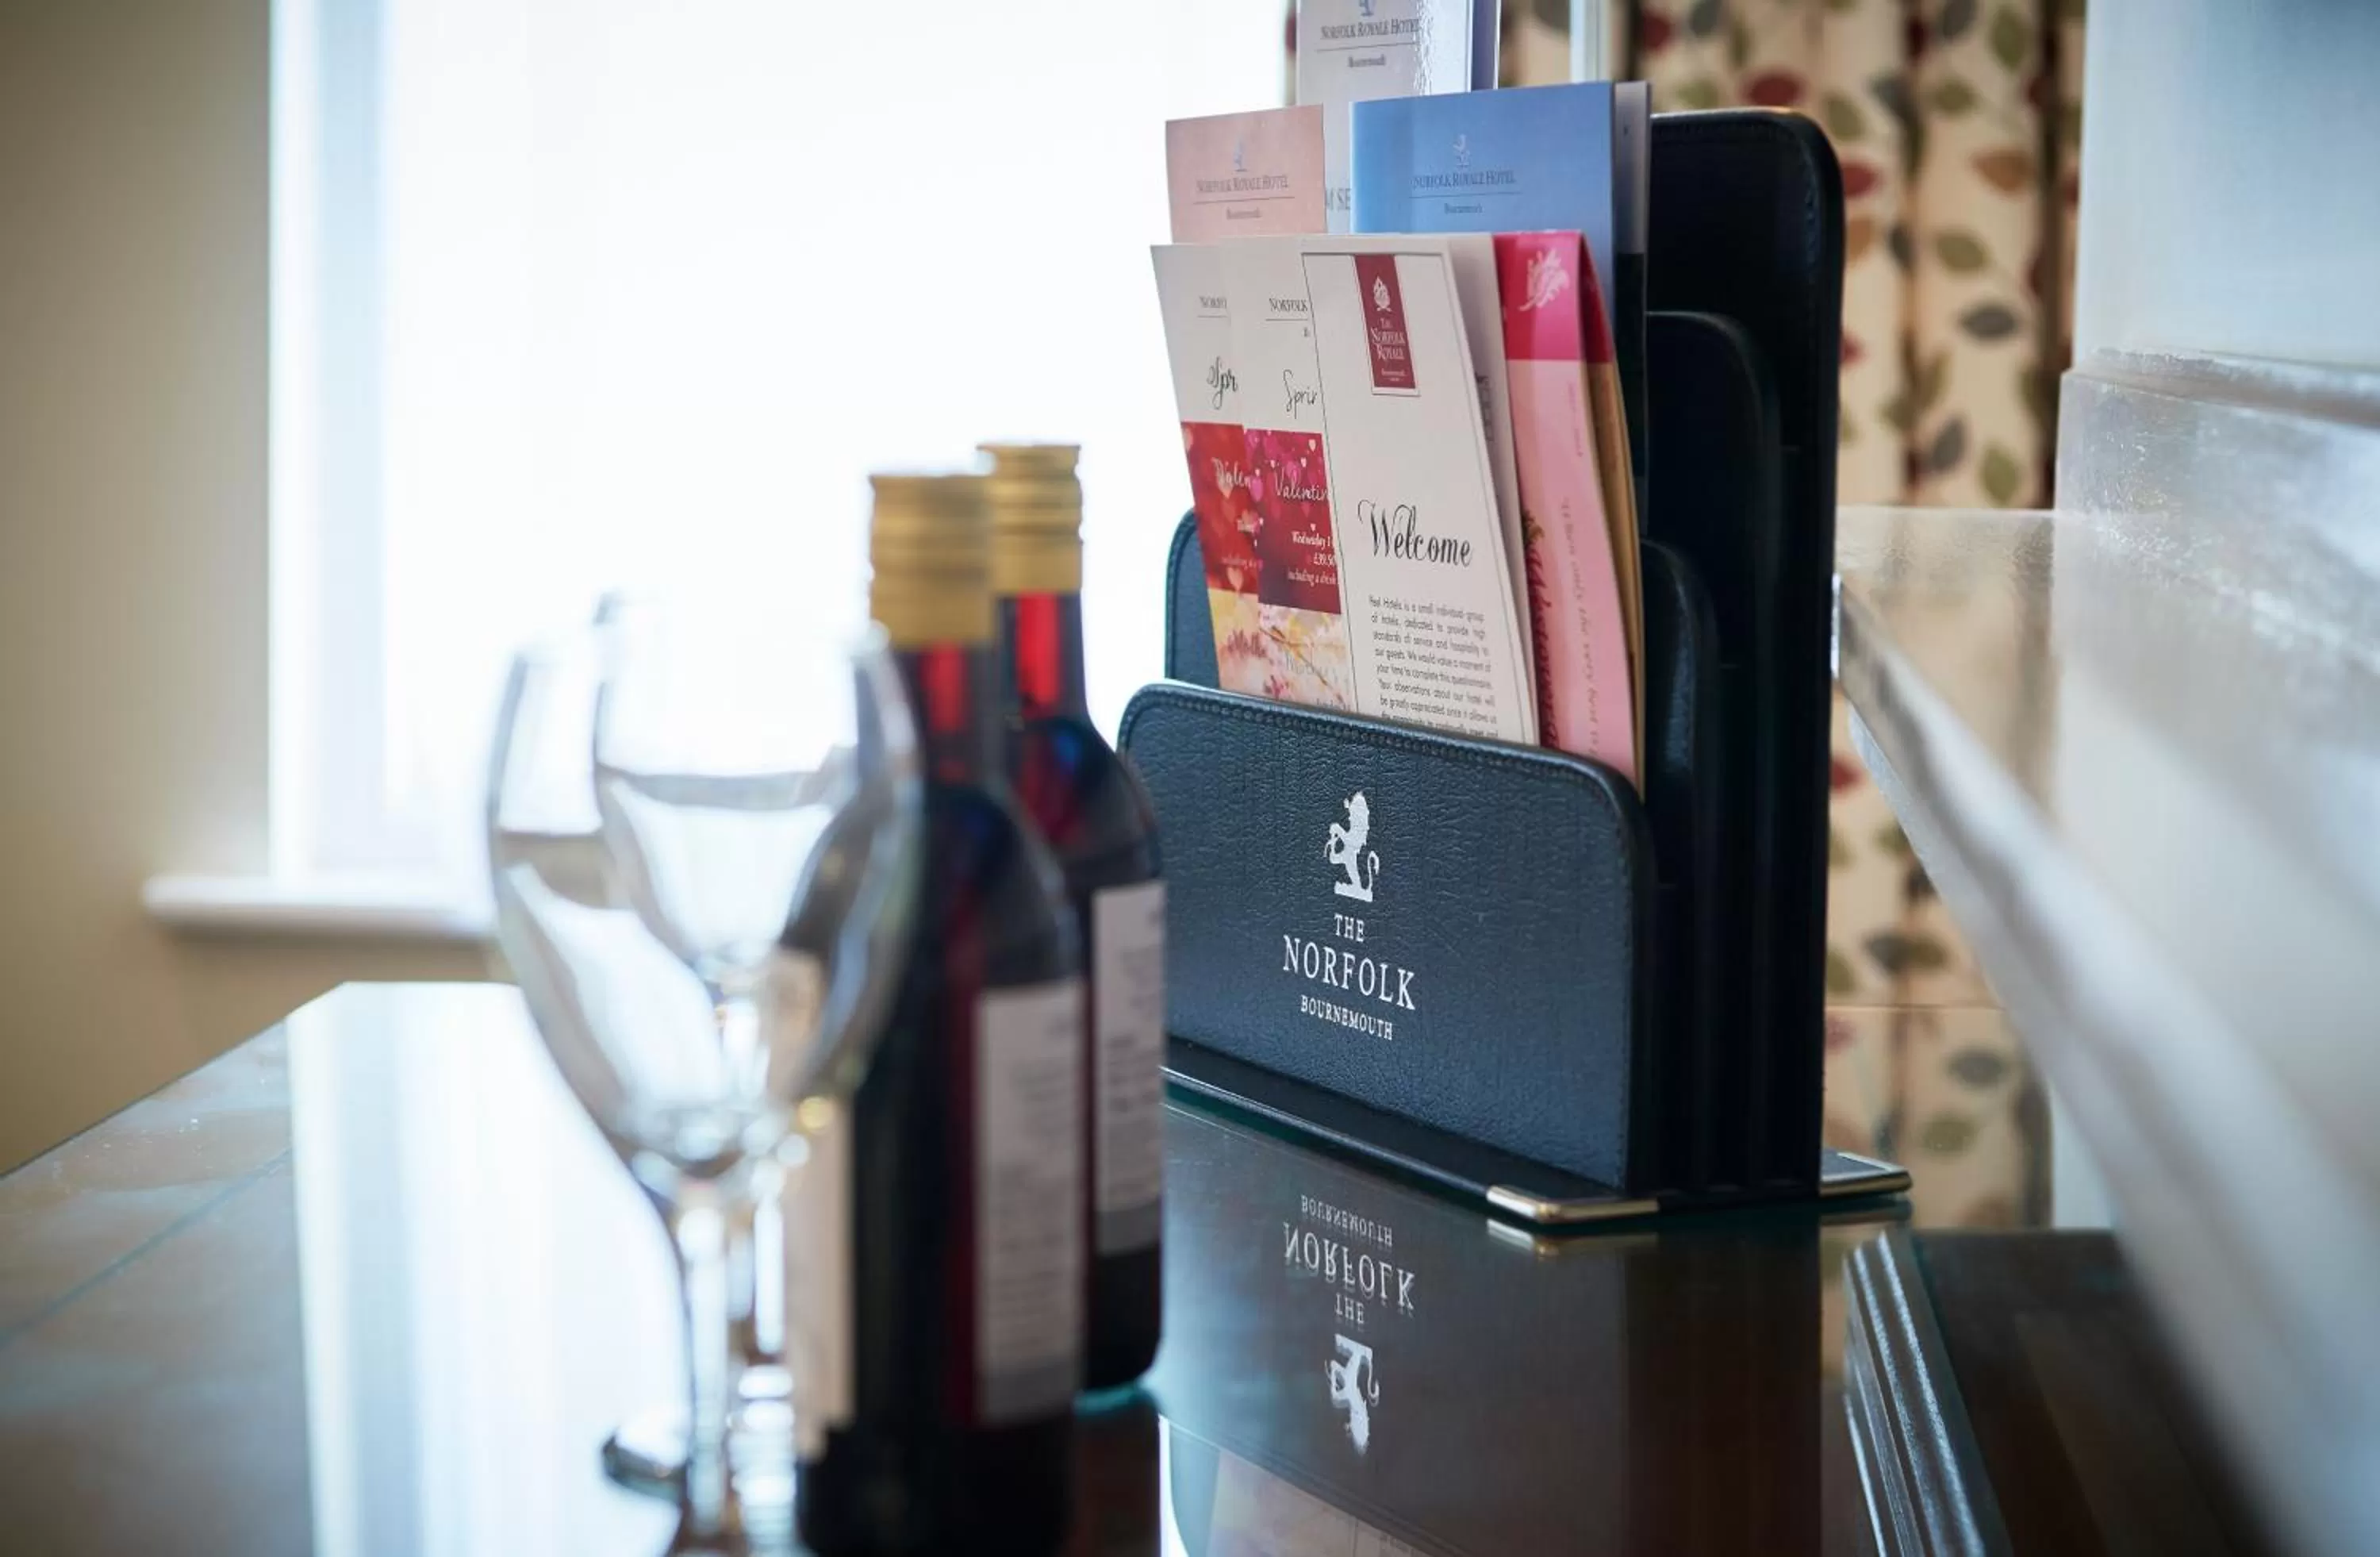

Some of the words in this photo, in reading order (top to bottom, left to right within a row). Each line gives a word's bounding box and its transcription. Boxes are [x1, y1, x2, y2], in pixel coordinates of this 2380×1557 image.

[1357, 499, 1472, 568] Welcome
[1334, 913, 1365, 942] THE
[1283, 934, 1415, 1010] NORFOLK
[1300, 994, 1393, 1040] BOURNEMOUTH
